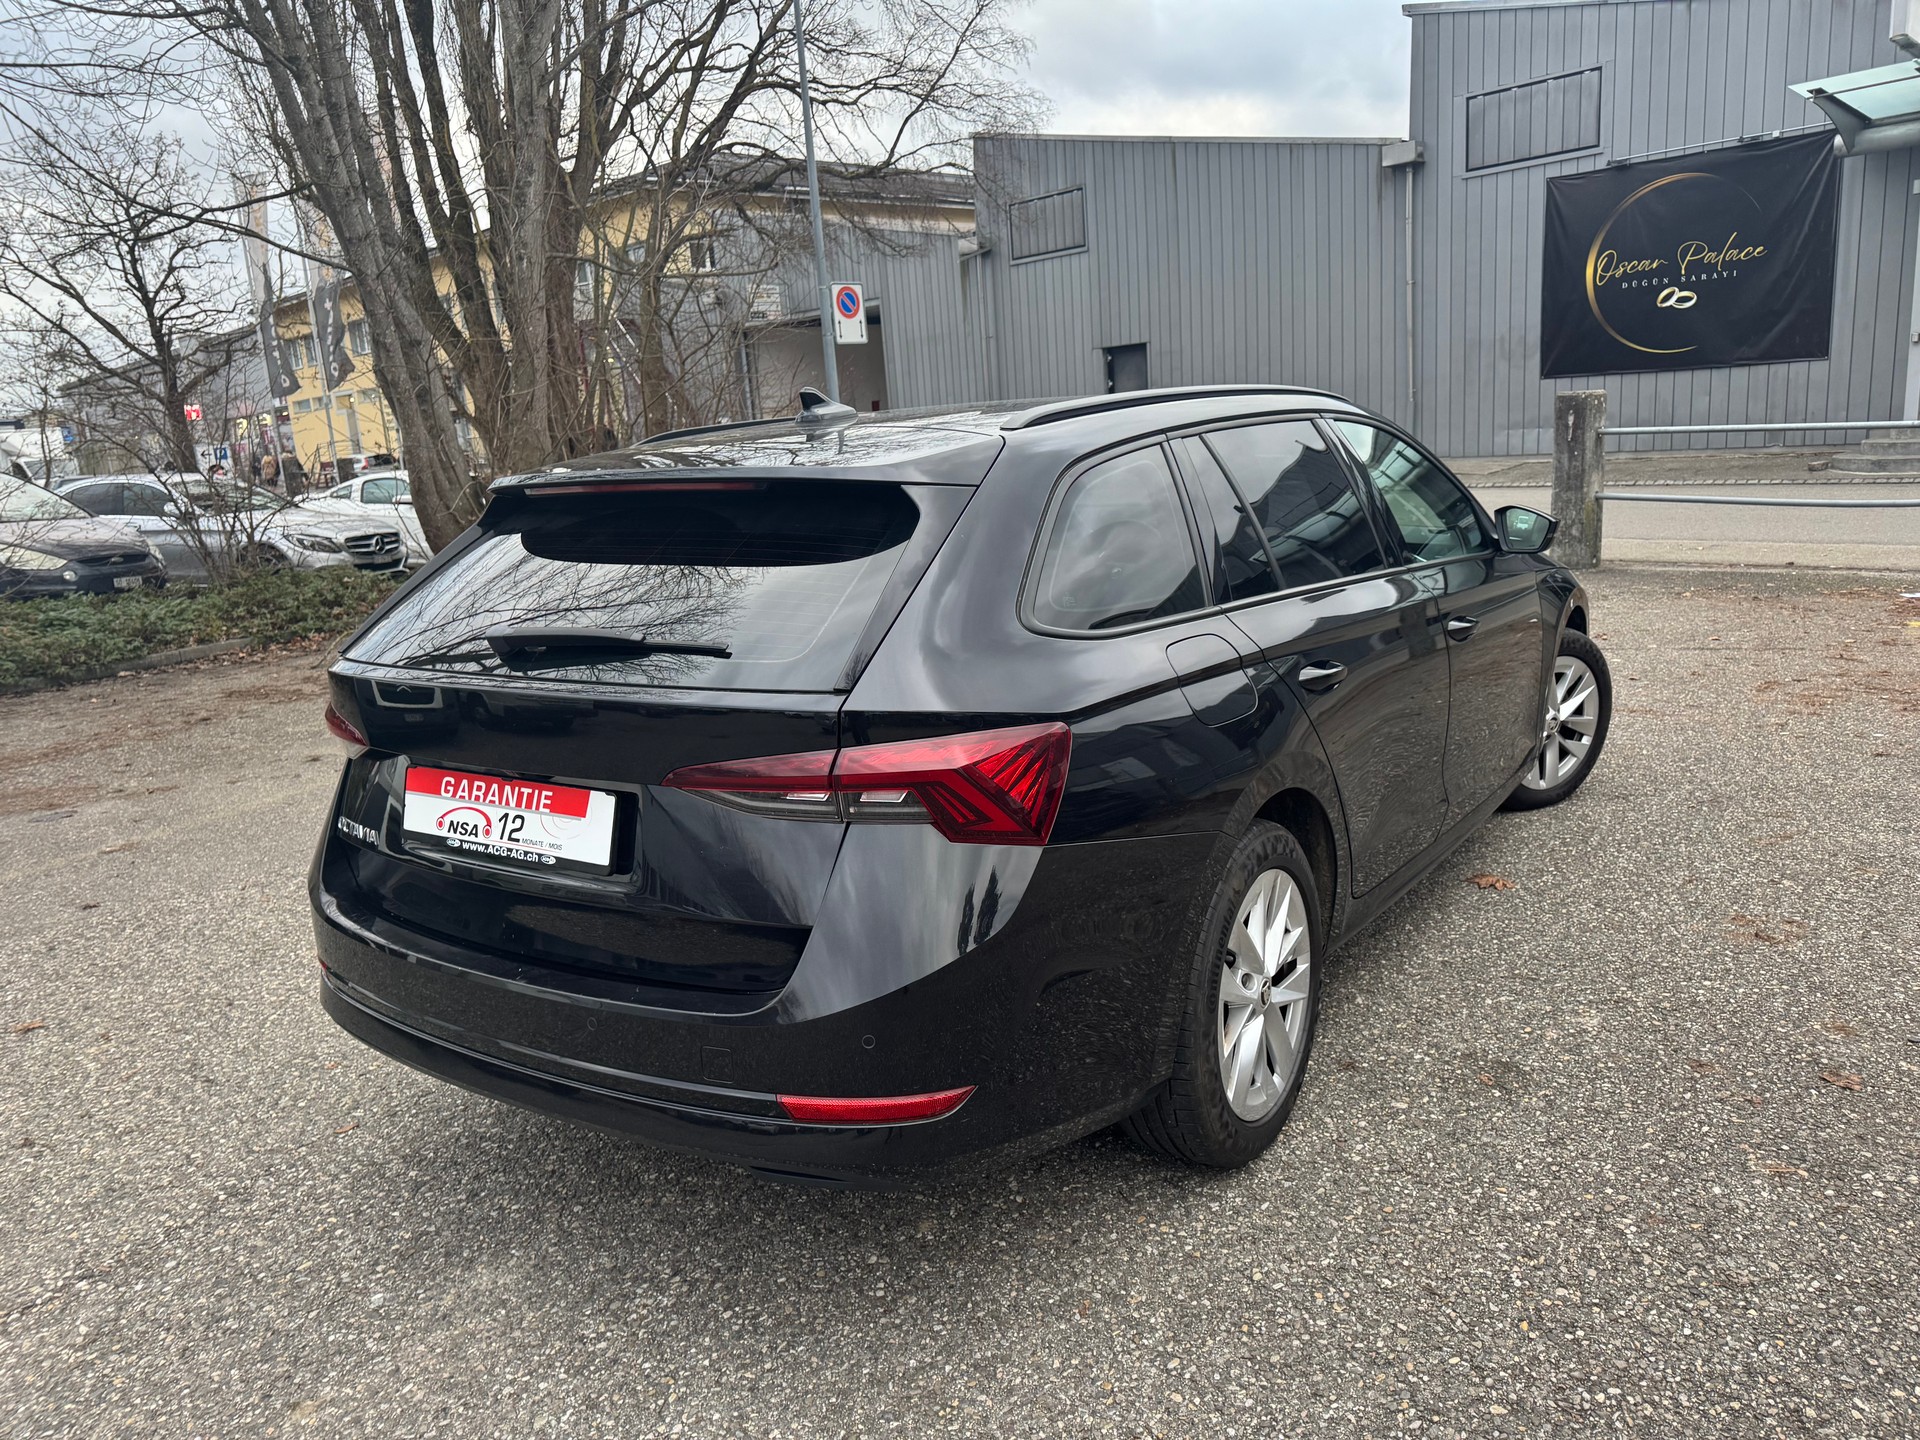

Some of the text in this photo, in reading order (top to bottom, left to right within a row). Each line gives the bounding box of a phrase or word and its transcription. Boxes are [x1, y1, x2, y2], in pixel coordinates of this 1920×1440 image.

[1596, 231, 1768, 286] Oscar Palace
[440, 776, 553, 813] GARANTIE
[447, 820, 479, 838] NSA
[498, 812, 526, 843] 12
[522, 838, 544, 848] MONATE
[548, 842, 563, 851] MOIS
[462, 841, 539, 863] www.ACG-AG.ch
